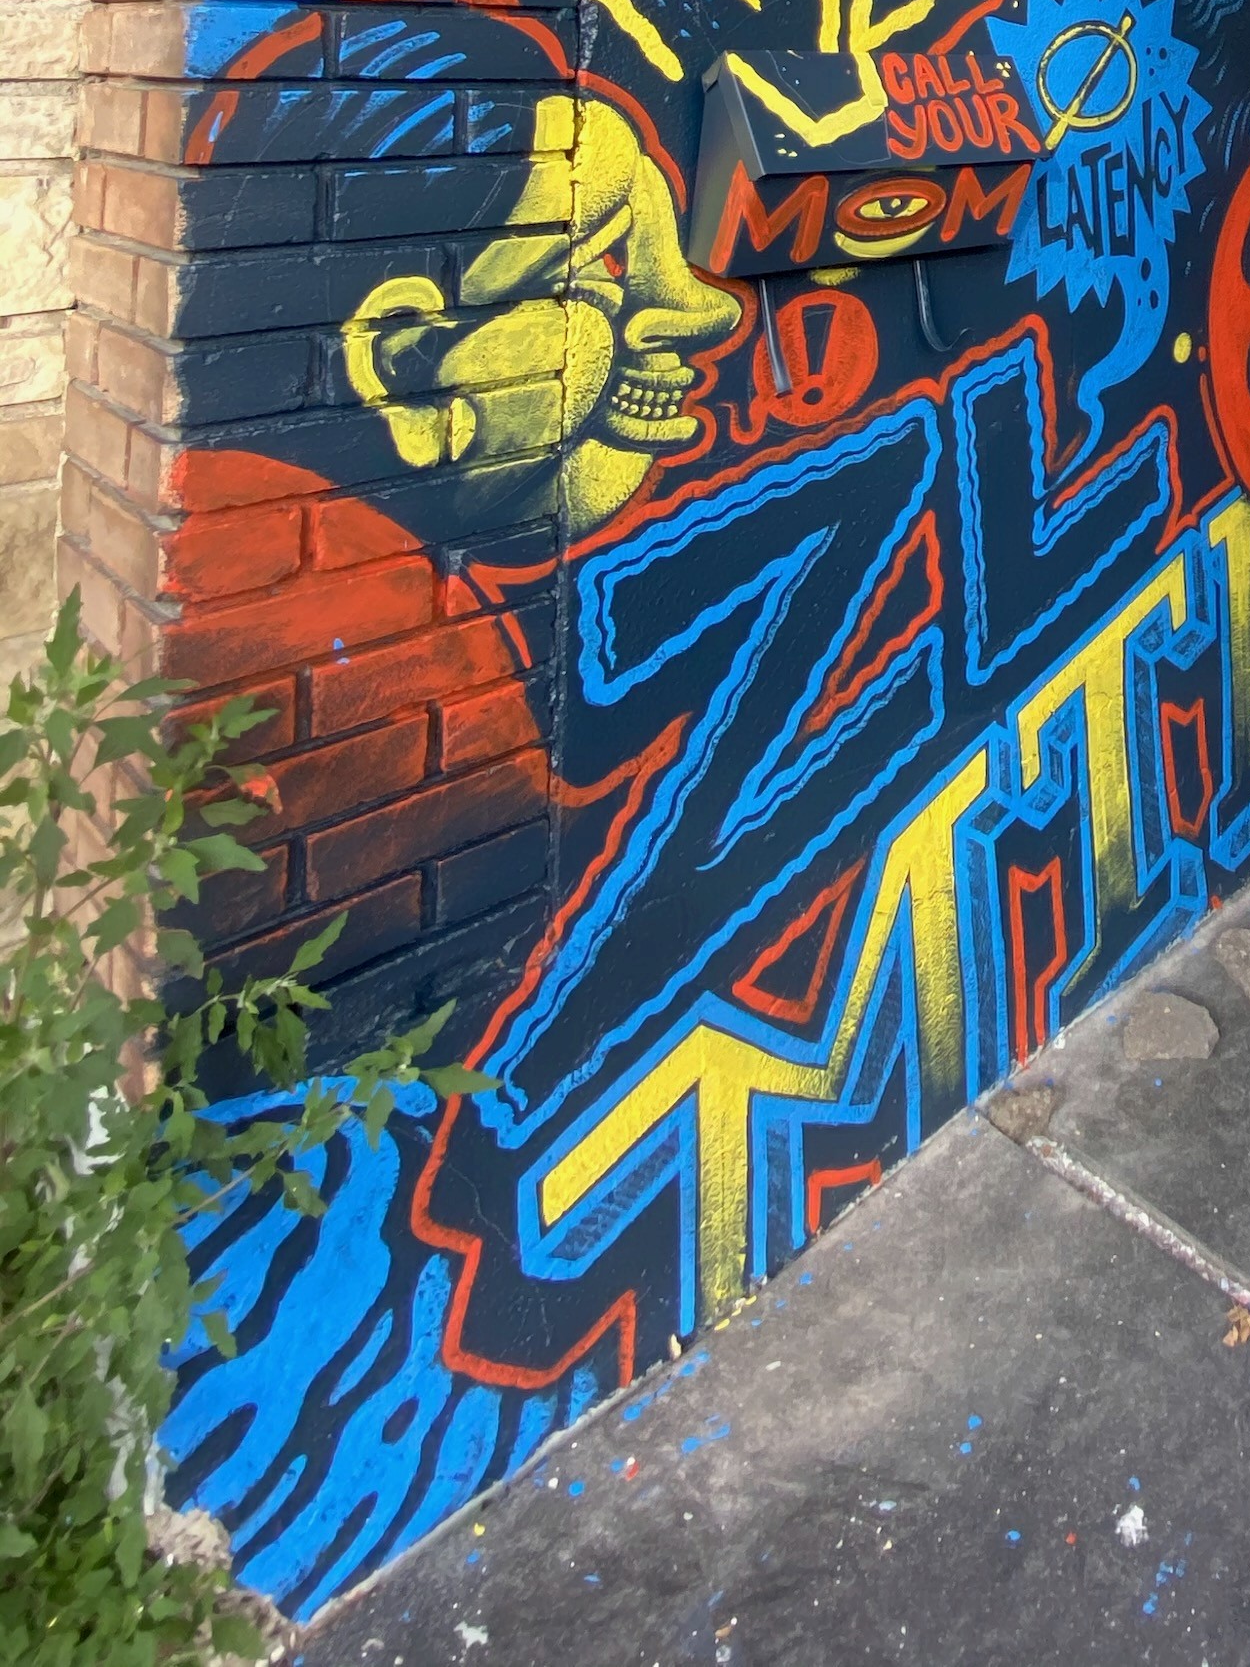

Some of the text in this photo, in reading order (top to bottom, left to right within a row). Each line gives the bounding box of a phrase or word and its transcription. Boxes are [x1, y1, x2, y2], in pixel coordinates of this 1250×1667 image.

[881, 51, 1006, 105] CALL
[887, 92, 1041, 160] YOUR
[1035, 90, 1190, 258] LATENCY
